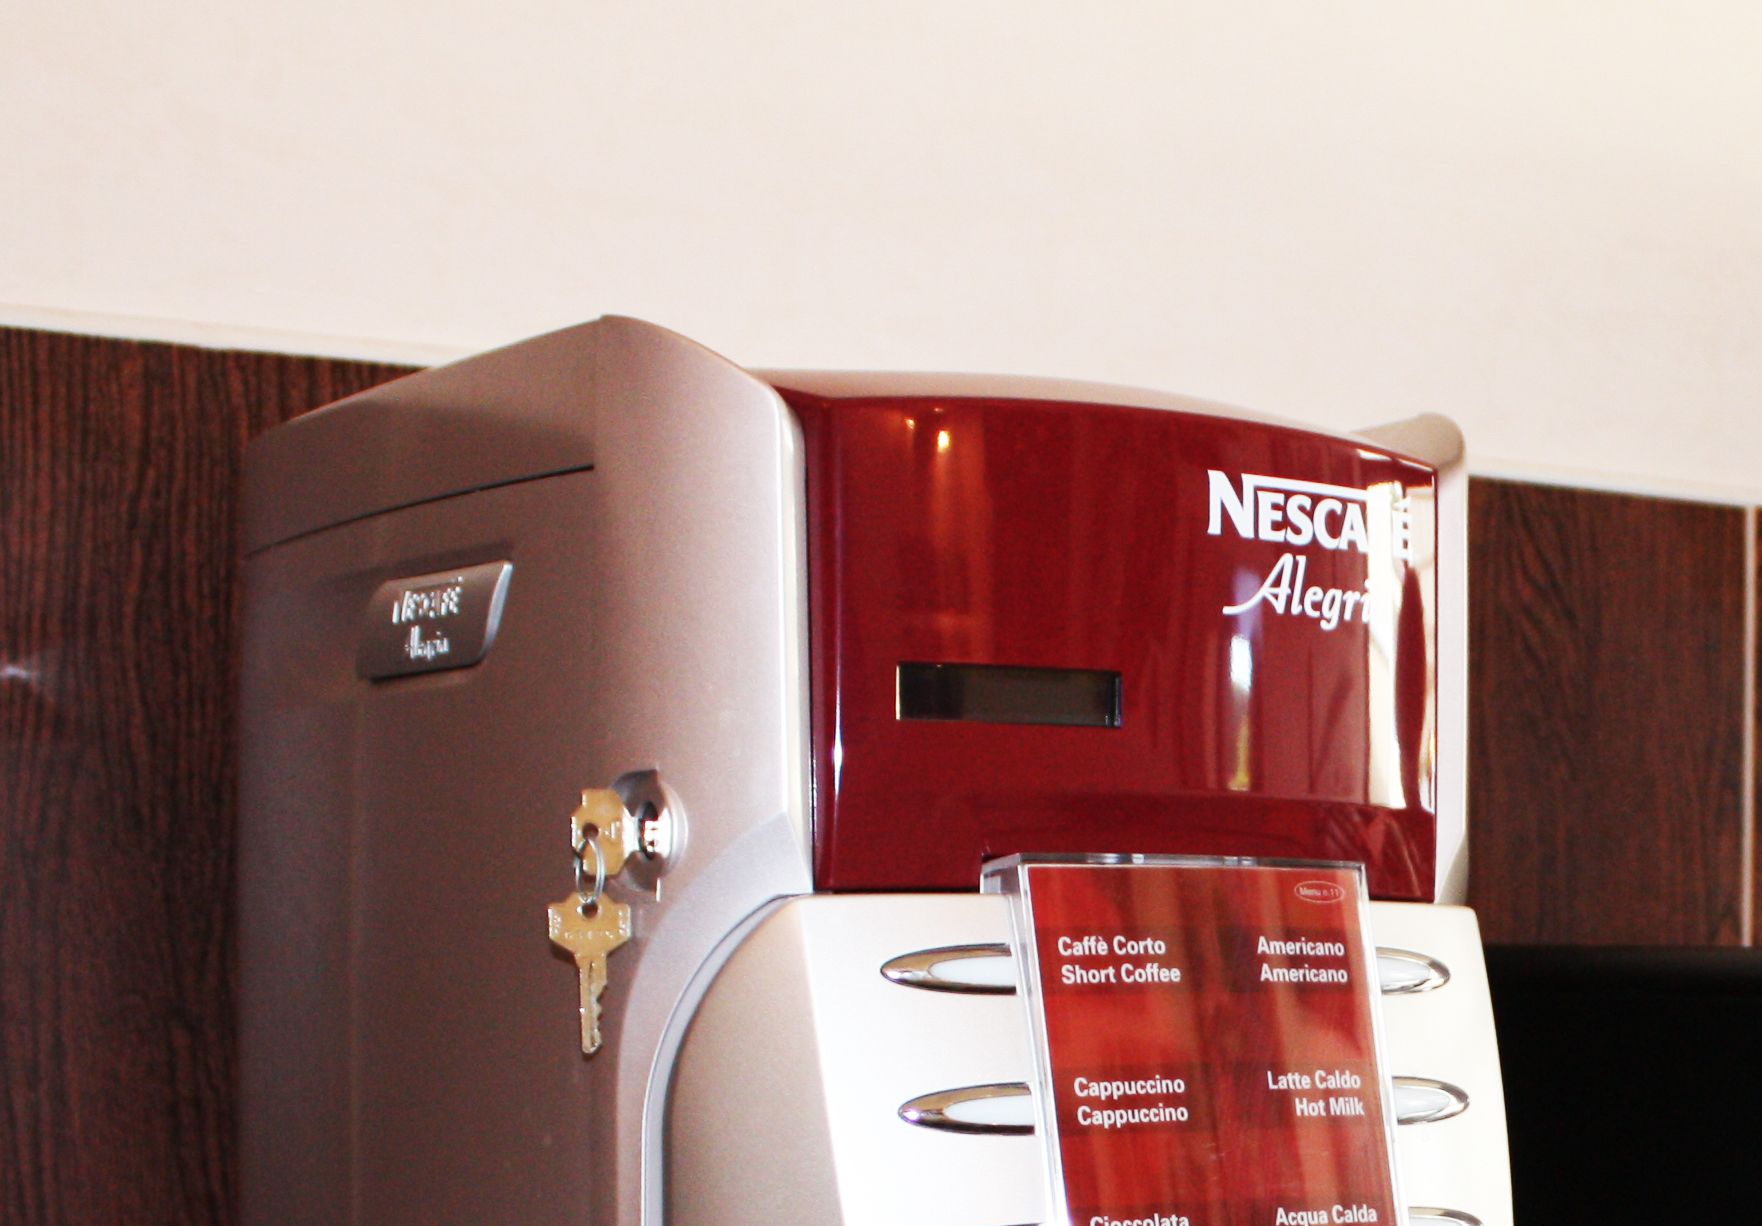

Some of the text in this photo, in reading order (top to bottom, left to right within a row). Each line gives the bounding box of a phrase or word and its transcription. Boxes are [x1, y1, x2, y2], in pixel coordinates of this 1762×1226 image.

[1206, 468, 1412, 563] NESCAÉ
[1222, 552, 1372, 631] Alegri
[1058, 936, 1166, 956] Caffè Corto
[1258, 936, 1344, 956] Americano
[1062, 963, 1180, 984] Short Coffee
[1261, 963, 1347, 983] Americano
[1074, 1075, 1185, 1100] Cappuccino
[1268, 1070, 1362, 1090] Latte Caldo
[1077, 1103, 1188, 1128] Cappuccino
[1295, 1096, 1366, 1117] Hot Milk
[1331, 1204, 1378, 1224] Calda
